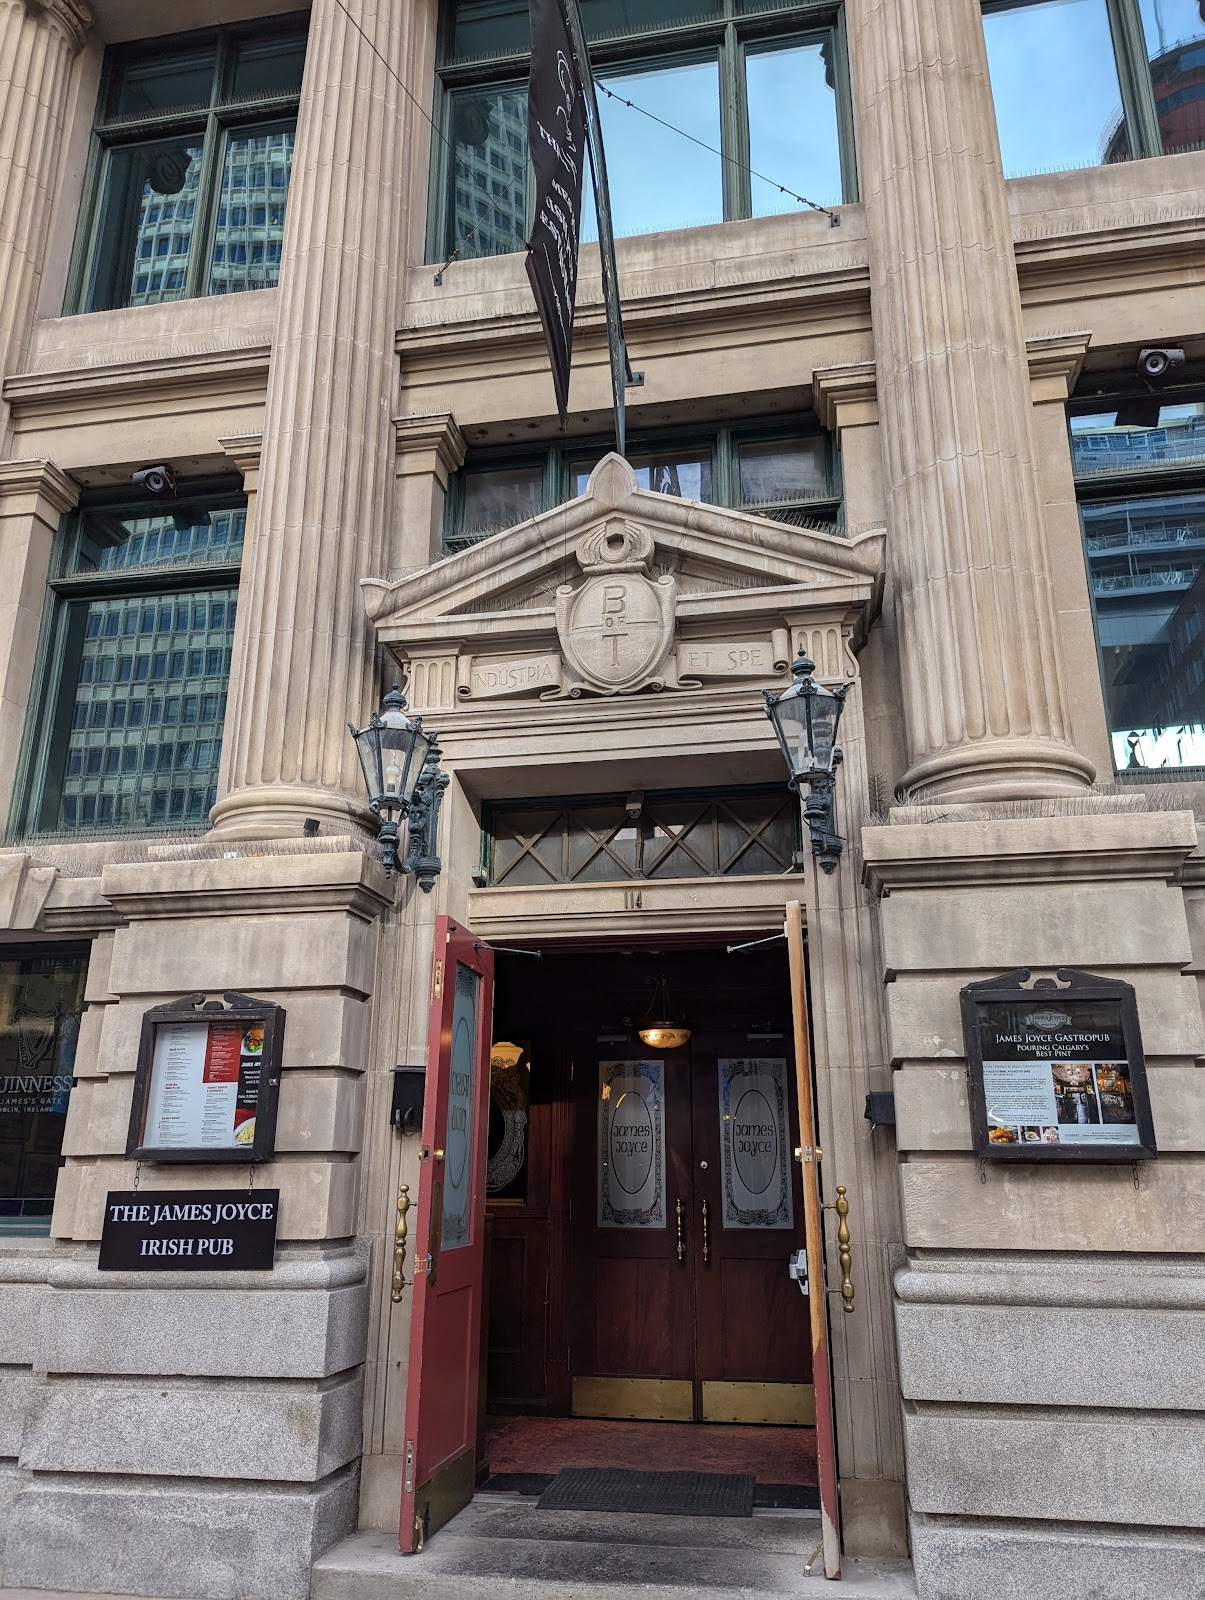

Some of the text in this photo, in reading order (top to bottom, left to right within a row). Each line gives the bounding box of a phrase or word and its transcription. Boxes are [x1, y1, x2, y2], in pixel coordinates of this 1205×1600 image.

[602, 584, 628, 615] B
[604, 616, 625, 629] OF
[601, 633, 629, 667] T
[688, 650, 713, 668] ET
[727, 649, 764, 671] SPE
[625, 891, 643, 909] 114
[995, 1033, 1110, 1043] JAMES JOYCE GASTROPUB
[613, 1124, 650, 1137] James
[735, 1123, 774, 1137] James
[615, 1141, 649, 1157] Joyce
[738, 1140, 772, 1157] Joyce
[109, 1203, 274, 1225] THE JAMES JOYCE
[139, 1238, 234, 1256] IRISH PUB
